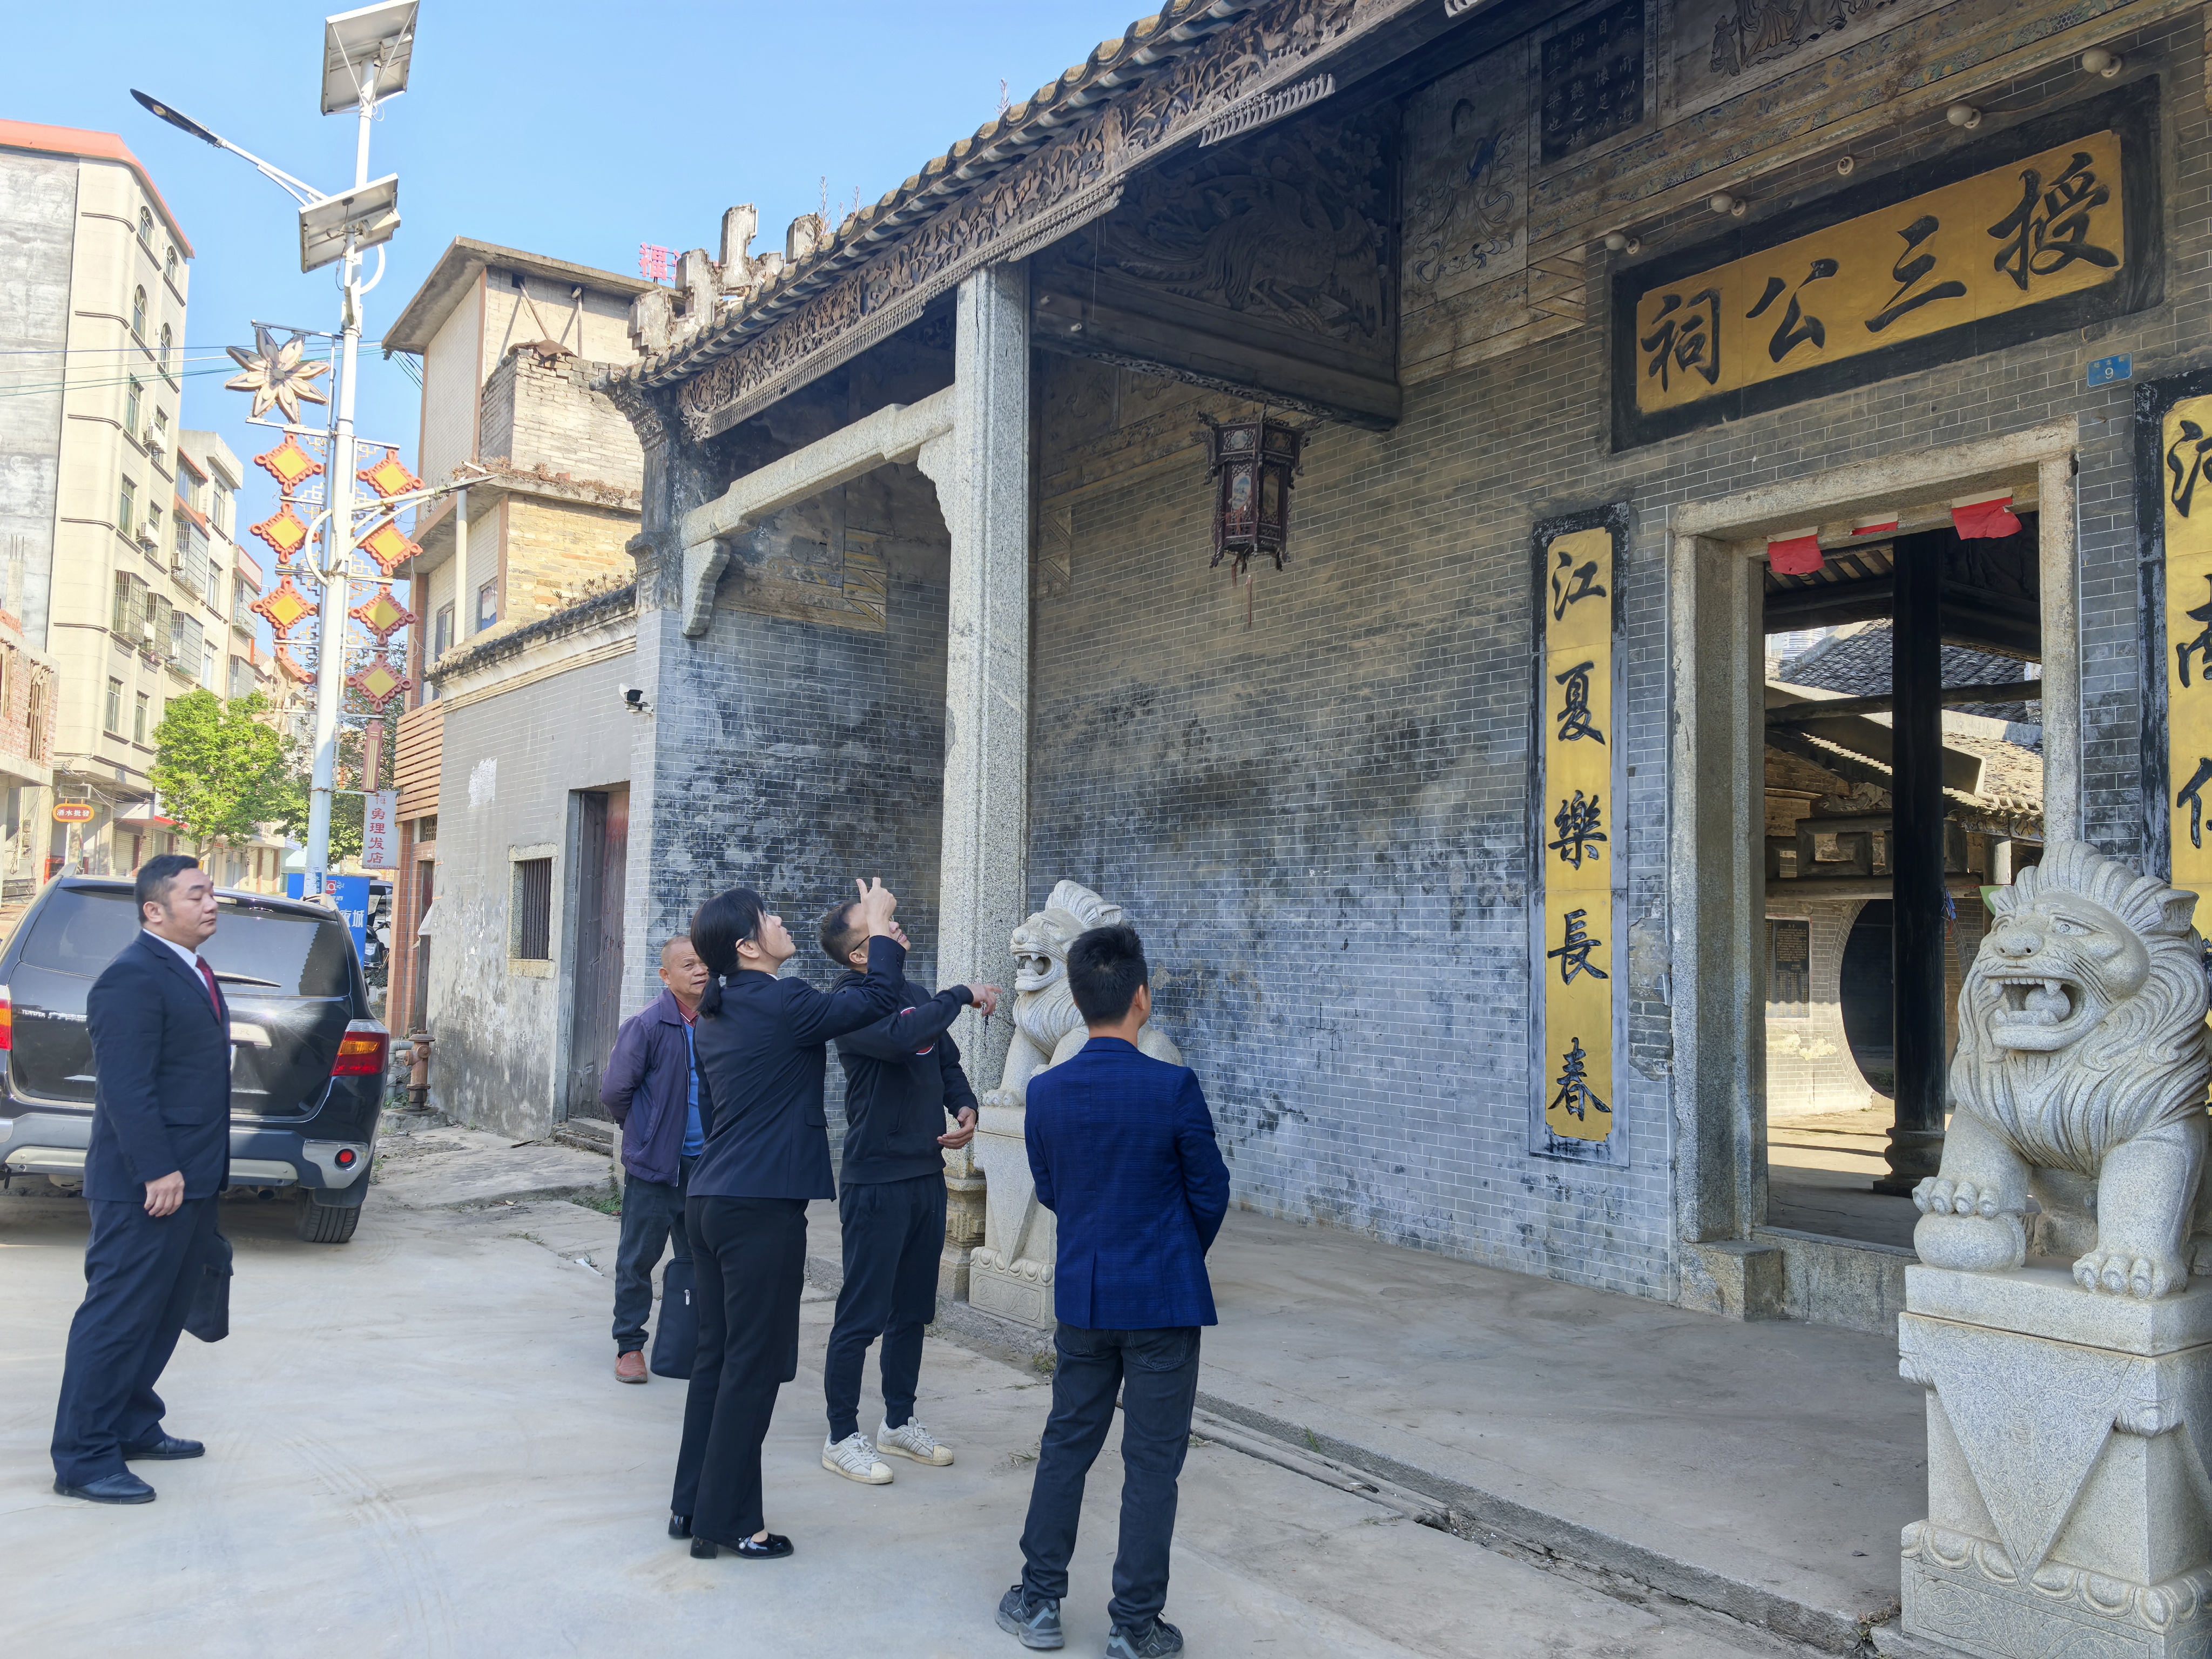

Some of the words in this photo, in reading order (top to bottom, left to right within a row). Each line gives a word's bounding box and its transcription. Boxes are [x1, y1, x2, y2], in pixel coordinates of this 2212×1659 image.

[2105, 367, 2114, 379] 9
[57, 809, 90, 817] 酒水批發
